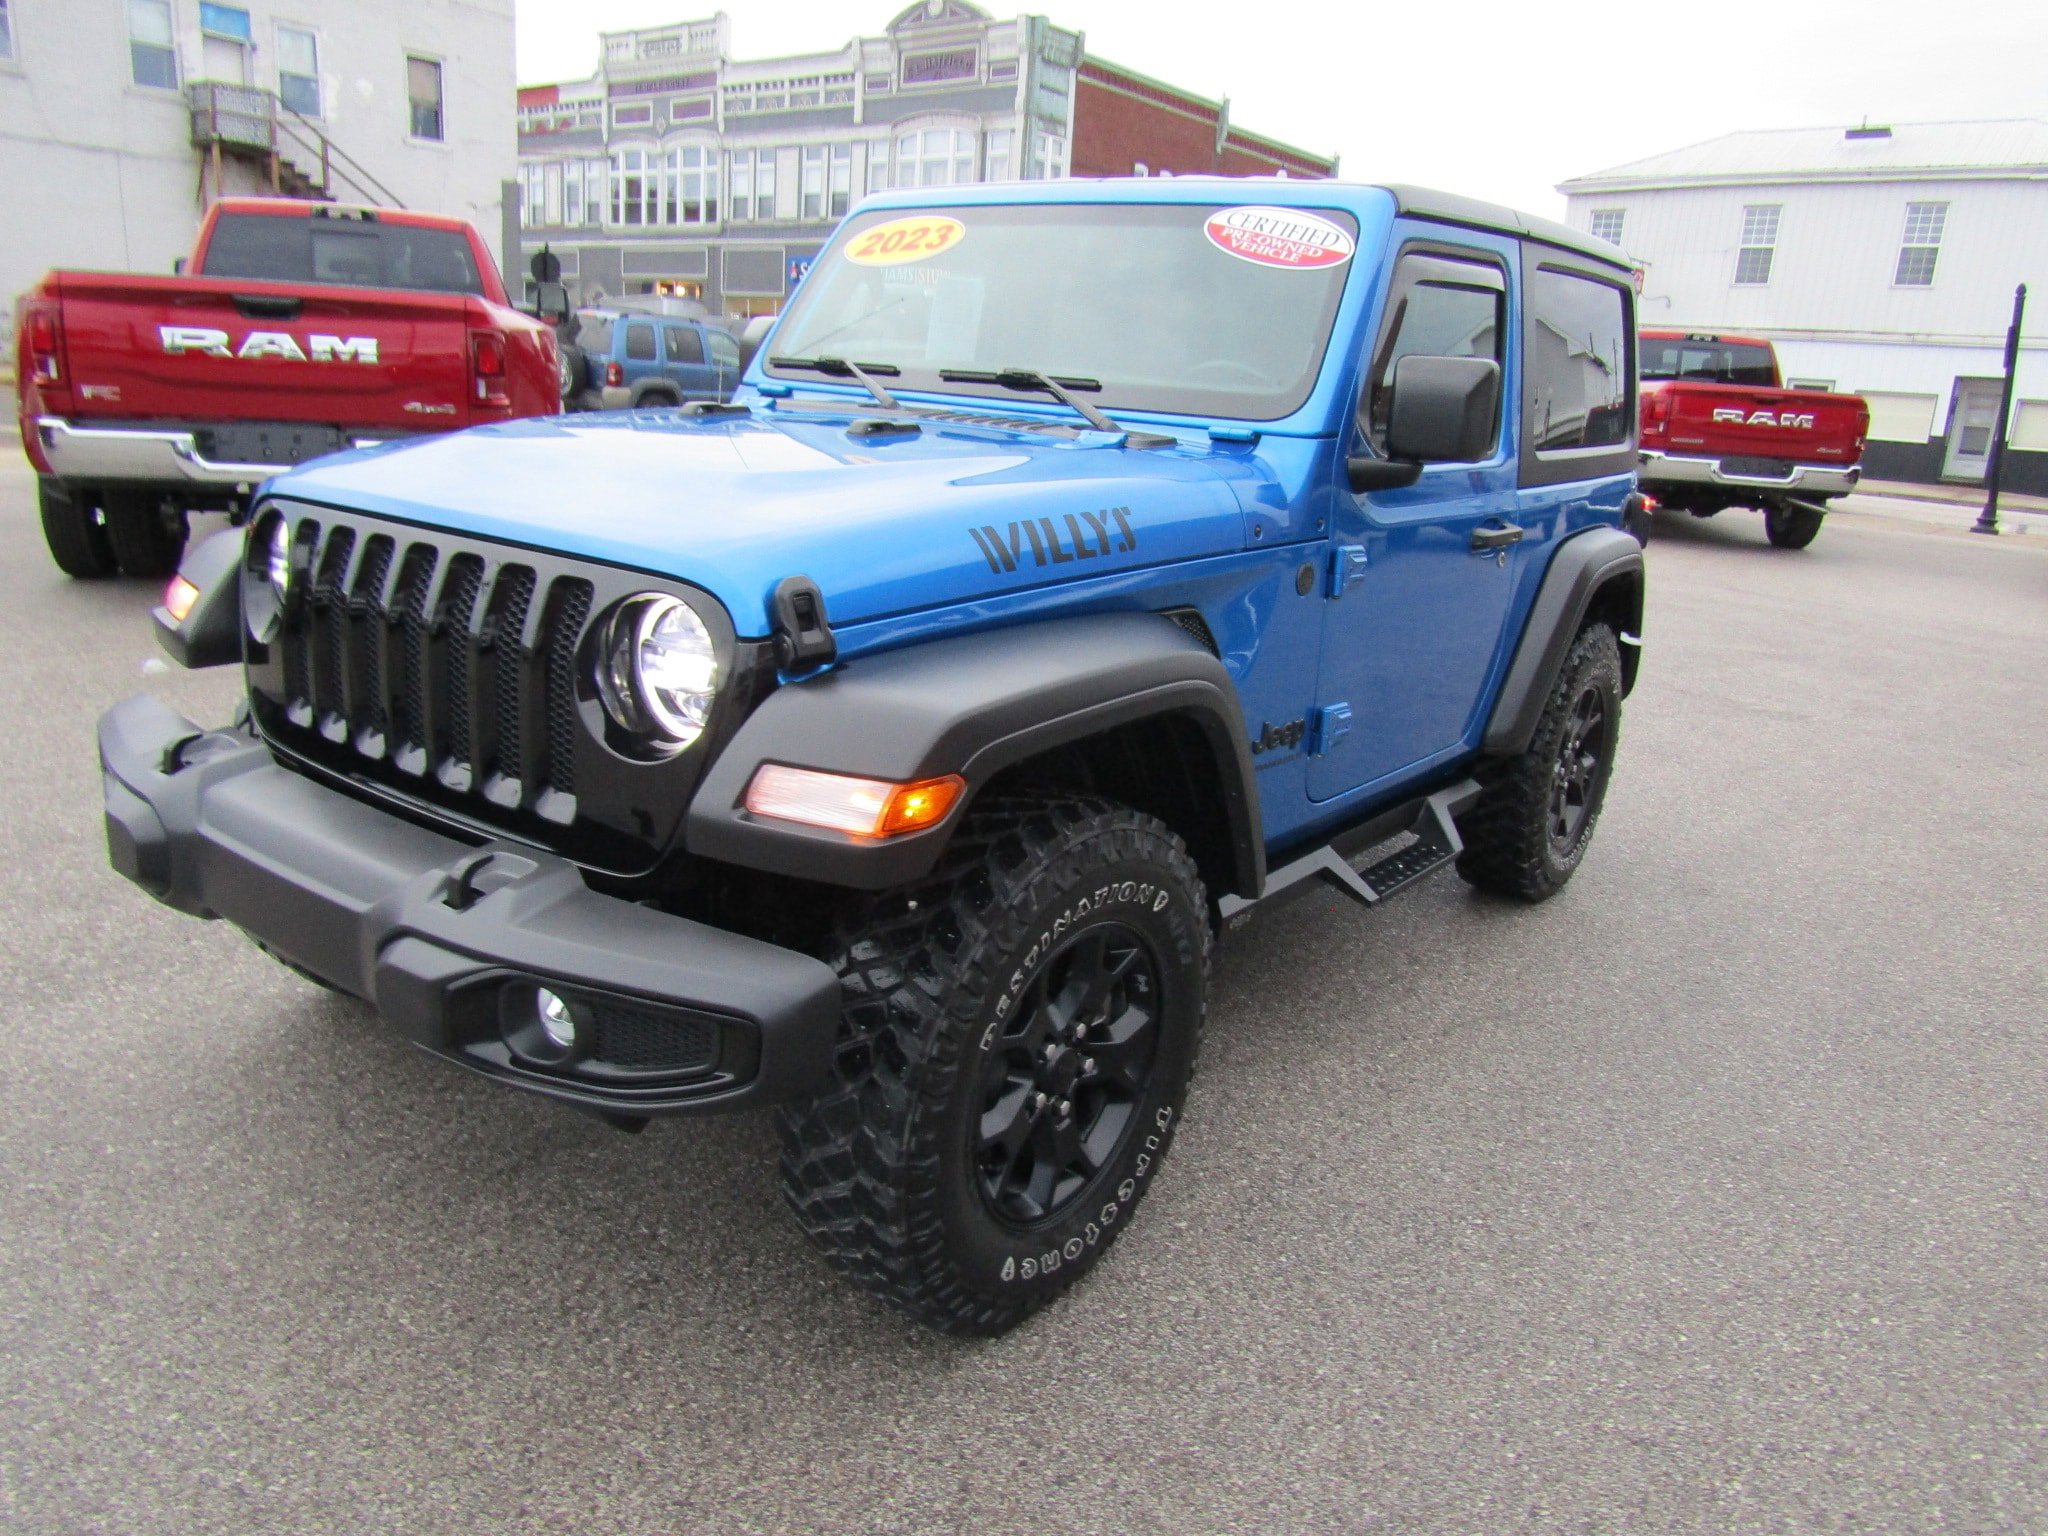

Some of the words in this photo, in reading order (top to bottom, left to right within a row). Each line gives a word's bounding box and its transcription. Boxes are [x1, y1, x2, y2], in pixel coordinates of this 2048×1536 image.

[855, 224, 955, 257] 2023
[1221, 226, 1323, 258] PRE-OWNED
[1226, 210, 1340, 248] CERTIFIED
[1229, 237, 1299, 263] VEHICLE
[158, 325, 380, 365] RAM
[1712, 408, 1815, 429] RAM
[967, 506, 1137, 575] WILLYS
[1251, 717, 1306, 755] Jeep
